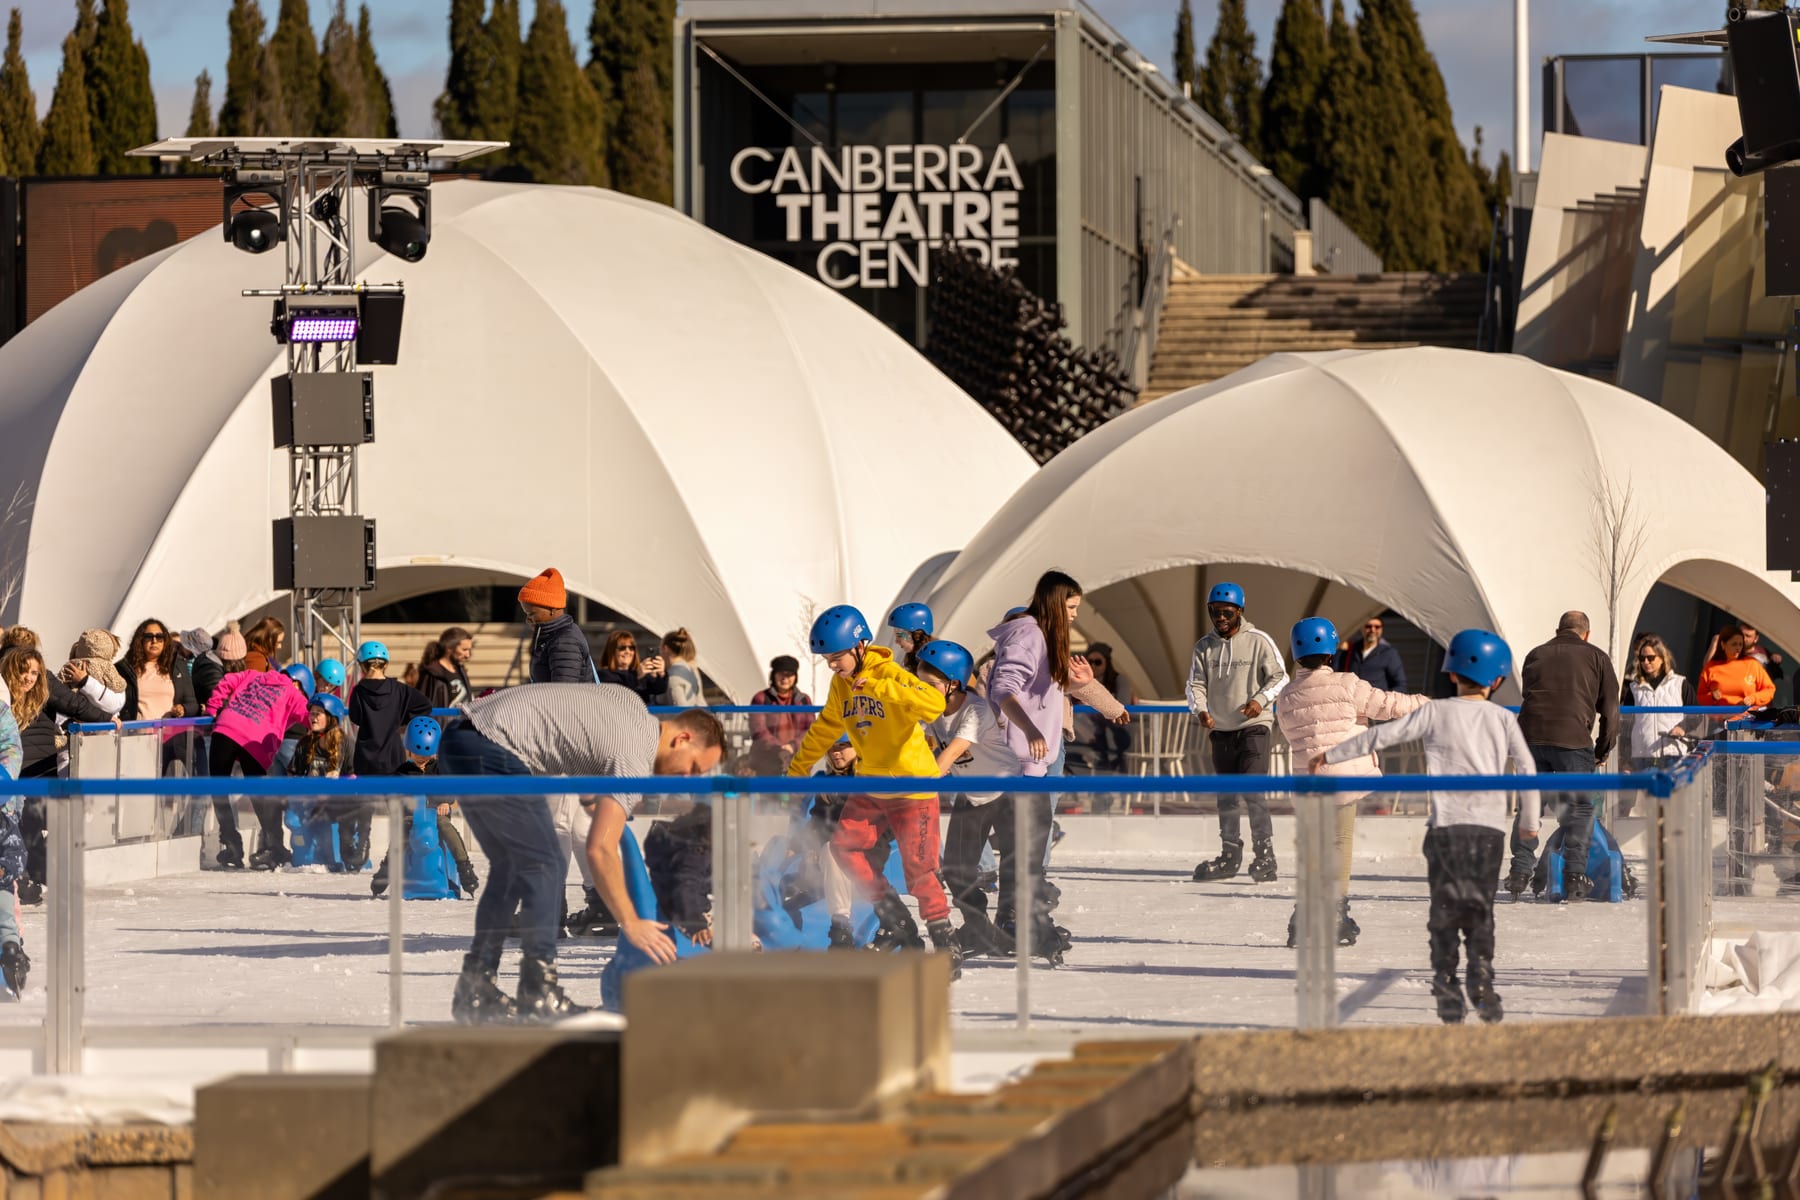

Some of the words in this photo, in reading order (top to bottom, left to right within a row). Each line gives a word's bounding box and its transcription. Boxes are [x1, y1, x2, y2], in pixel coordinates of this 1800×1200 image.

[730, 143, 1024, 194] CANBERRA
[776, 191, 1019, 242] THEATRE
[842, 695, 886, 719] LAERS
